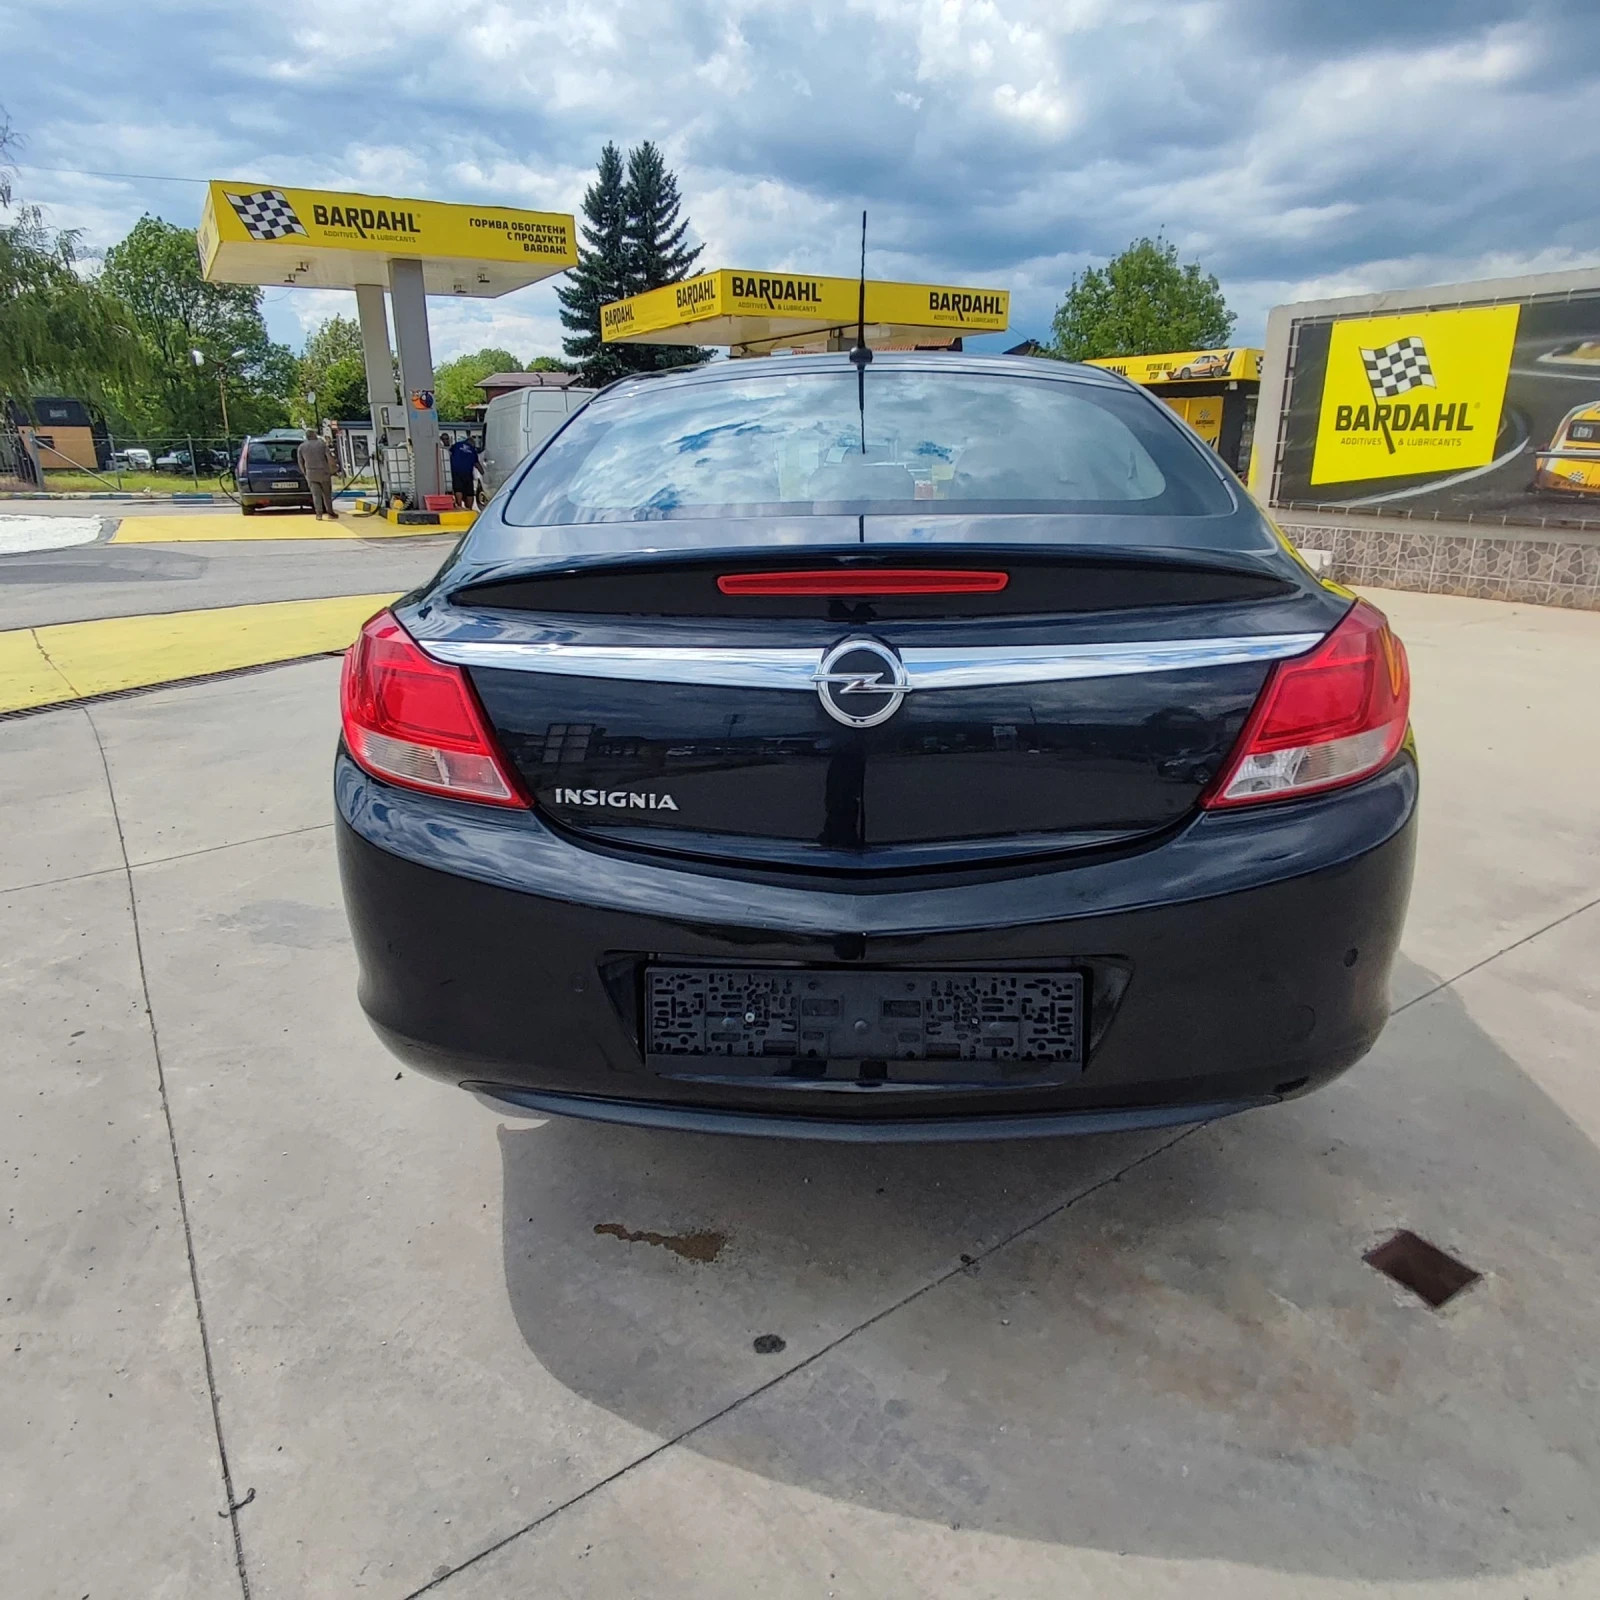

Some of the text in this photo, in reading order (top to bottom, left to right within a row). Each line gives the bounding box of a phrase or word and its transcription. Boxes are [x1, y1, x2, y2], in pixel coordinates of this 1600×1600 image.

[313, 204, 421, 239] BARDAHL
[469, 218, 566, 234] ГОРИВА ОБОГАТЕНИ
[323, 230, 358, 239] ADDITIVES
[377, 234, 416, 243] LUBRICANTS
[514, 232, 567, 244] ПРОДУКТИ
[523, 243, 567, 254] BARDAHL
[676, 279, 716, 314] BARDAHL
[731, 276, 822, 309] BARDAHL
[738, 301, 767, 309] ADDITIVES
[783, 304, 817, 312] LUBRICANTS
[929, 292, 1003, 322] BARDAHL
[605, 304, 635, 332] BARDAHL
[1106, 365, 1128, 377] AHL
[1334, 402, 1474, 455] BARDAHL
[1340, 437, 1462, 447] ADDITIVES & LUBRICANTS
[555, 788, 680, 811] INSIGNIA
